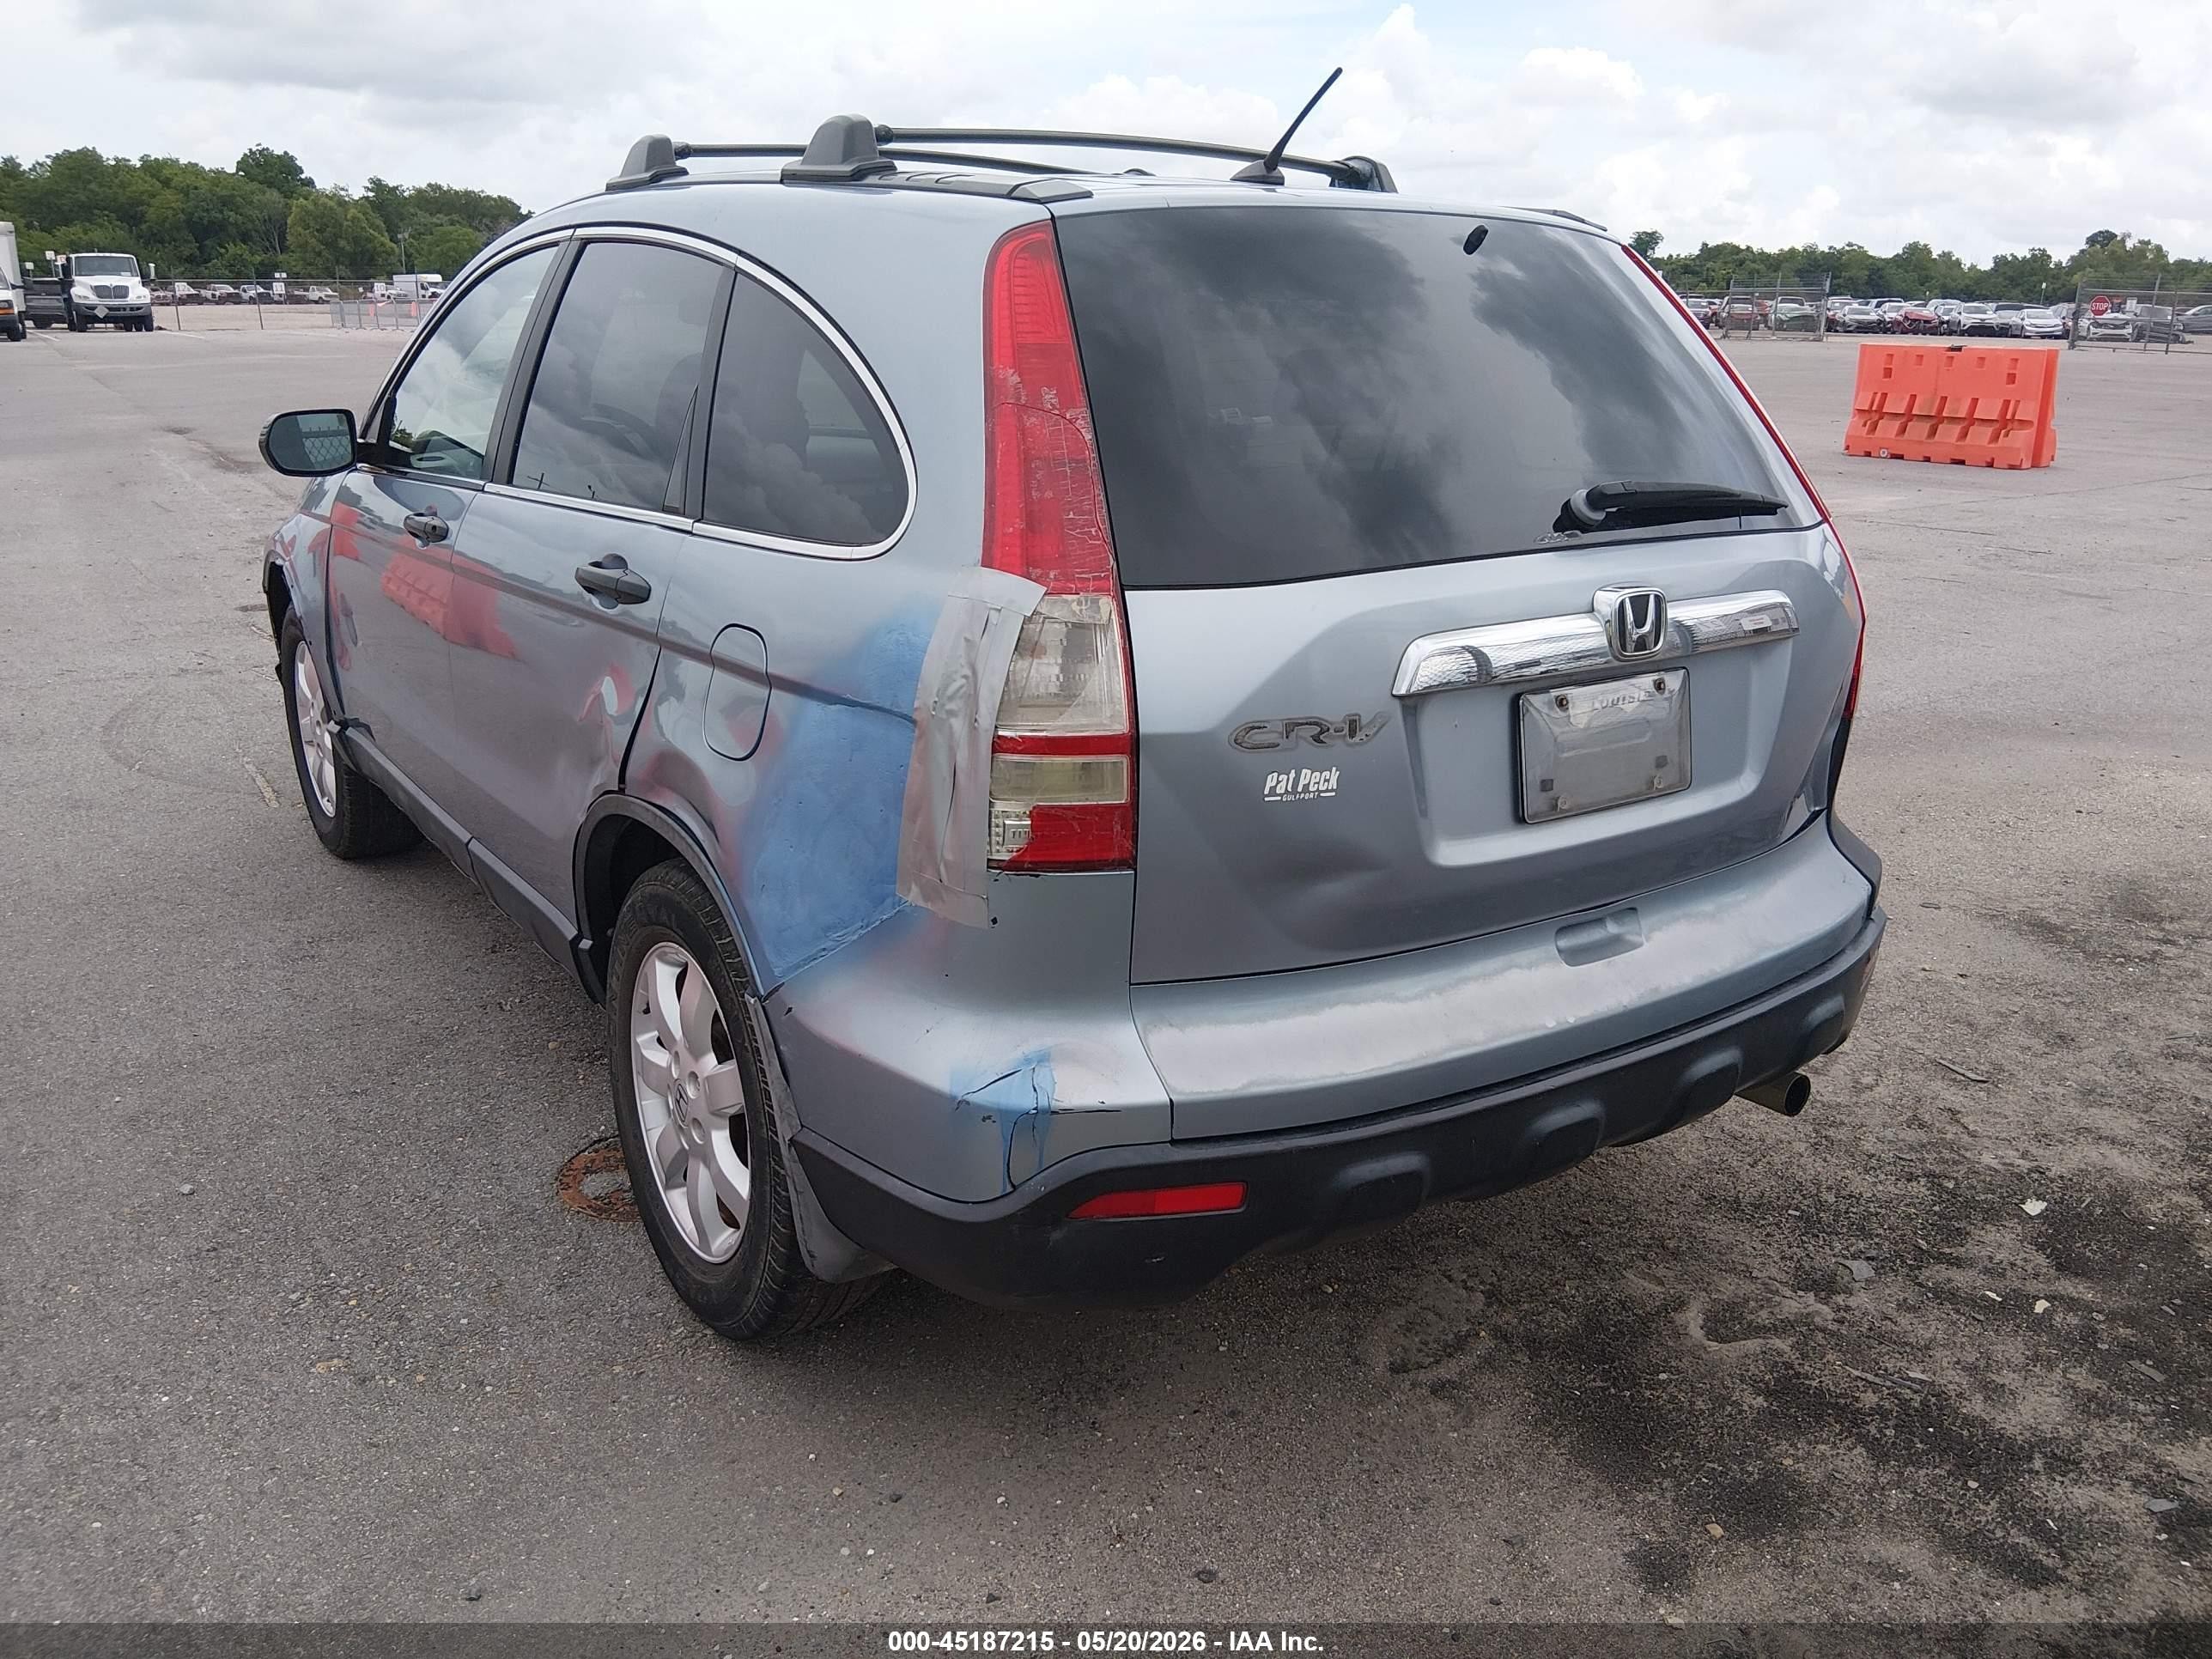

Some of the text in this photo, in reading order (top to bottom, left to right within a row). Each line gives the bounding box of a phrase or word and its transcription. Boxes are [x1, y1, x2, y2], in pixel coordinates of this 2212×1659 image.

[2091, 302, 2109, 311] STOP
[1229, 713, 1391, 753] CR-V
[1263, 766, 1340, 795] Pat Peck
[1282, 792, 1319, 802] GULFPORT
